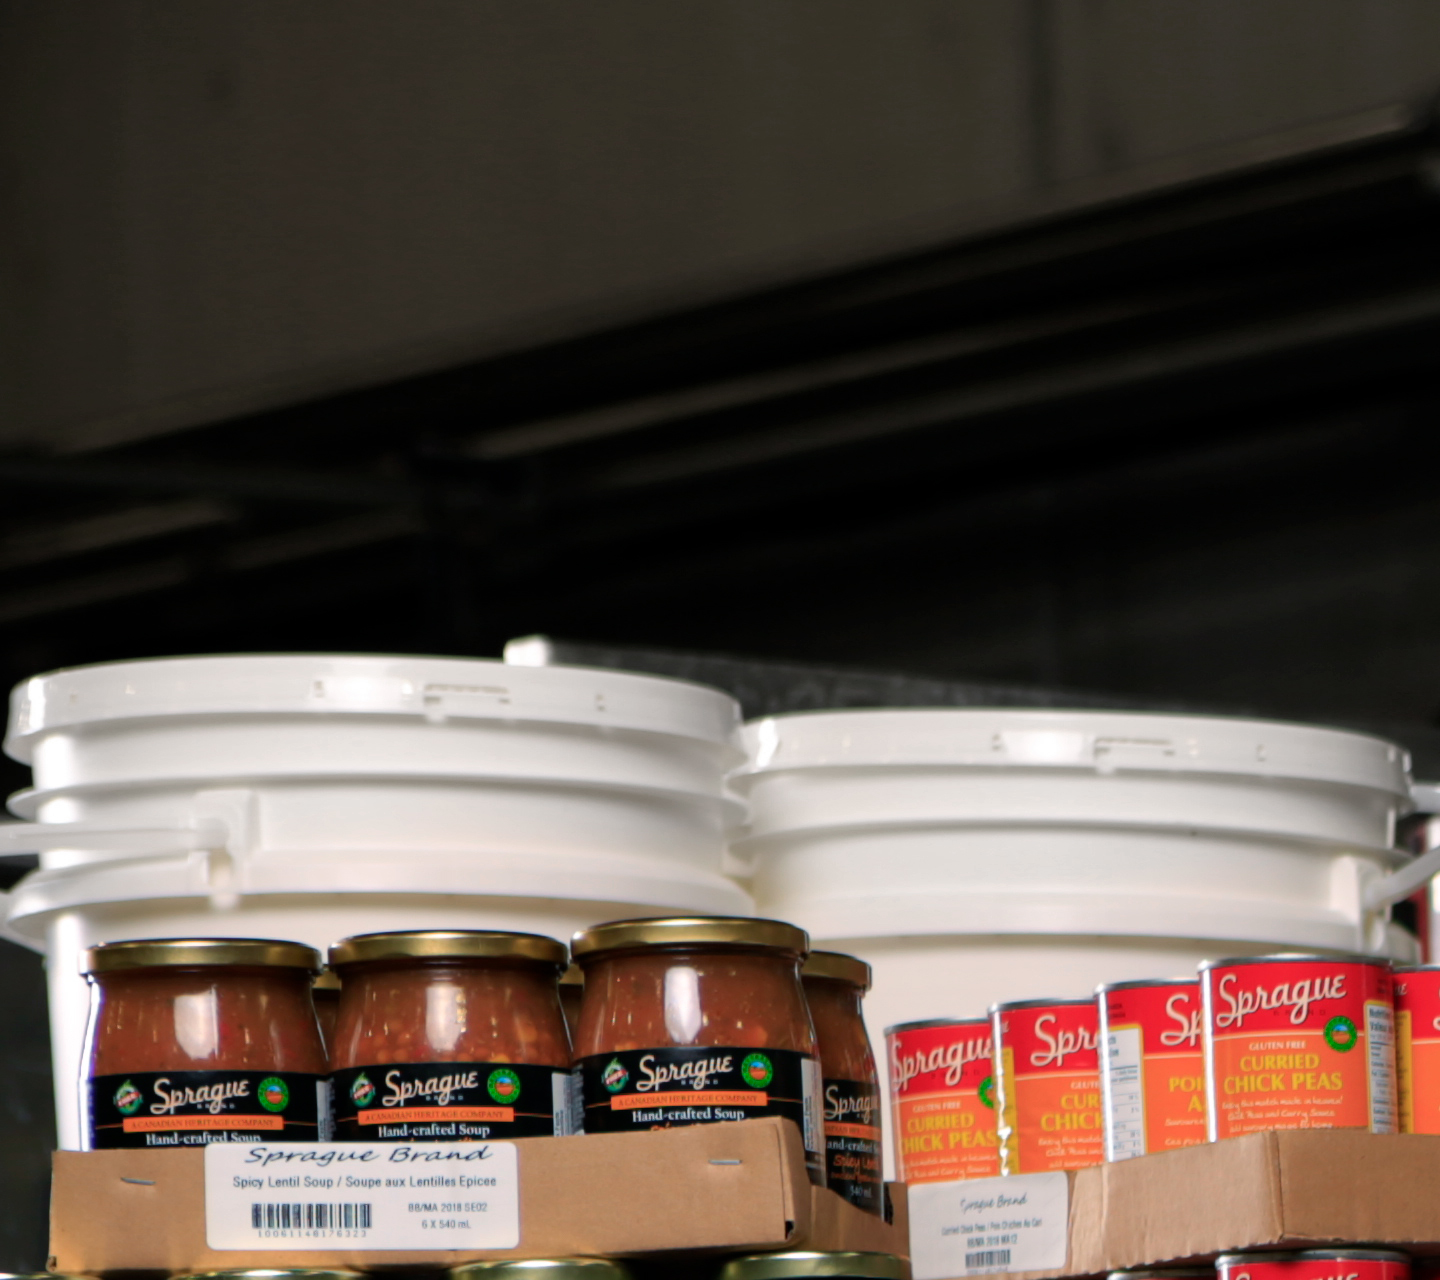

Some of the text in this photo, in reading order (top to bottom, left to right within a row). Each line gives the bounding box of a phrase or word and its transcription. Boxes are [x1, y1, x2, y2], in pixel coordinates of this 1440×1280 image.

[1216, 974, 1346, 1027] Sprague
[1249, 1040, 1306, 1051] GLUTEN FREE
[1239, 1053, 1320, 1072] CURRIED
[636, 1055, 734, 1091] Sprague
[382, 1070, 479, 1107] Sprague
[1223, 1072, 1343, 1095] CHICK PEAS
[150, 1077, 250, 1115] Sprague
[625, 1097, 666, 1106] CANADIAN
[669, 1096, 713, 1104] HERITAGE
[715, 1095, 758, 1103] COMPANY
[632, 1107, 745, 1122] Hand-crafted Soup
[913, 1101, 961, 1113] GLUTEN FREE
[138, 1120, 183, 1128] CANADIAN
[185, 1119, 229, 1127] HERITAGE
[231, 1119, 274, 1127] COMPANY
[371, 1113, 412, 1122] CANADIAN
[414, 1111, 458, 1119] HERITAGE
[459, 1110, 504, 1118] COMPANY
[907, 1113, 975, 1134] CURRIED
[378, 1123, 490, 1138] Hand-crafted Soup
[146, 1131, 228, 1146] Hand-crafted
[949, 1131, 997, 1149] PEAS
[244, 1145, 494, 1167] Sprague Brand
[233, 1176, 264, 1189] Spicy
[268, 1176, 300, 1188] Lentil
[304, 1177, 333, 1190] Soup
[337, 1177, 342, 1188] /
[346, 1177, 381, 1190] Soupe
[386, 1179, 406, 1188] aux
[410, 1176, 456, 1188] Lentilles
[408, 1203, 438, 1212] BB/MA
[440, 1203, 462, 1212] 2018
[997, 1192, 1028, 1209] Brand
[422, 1220, 428, 1229] 6
[439, 1220, 456, 1229] 540
